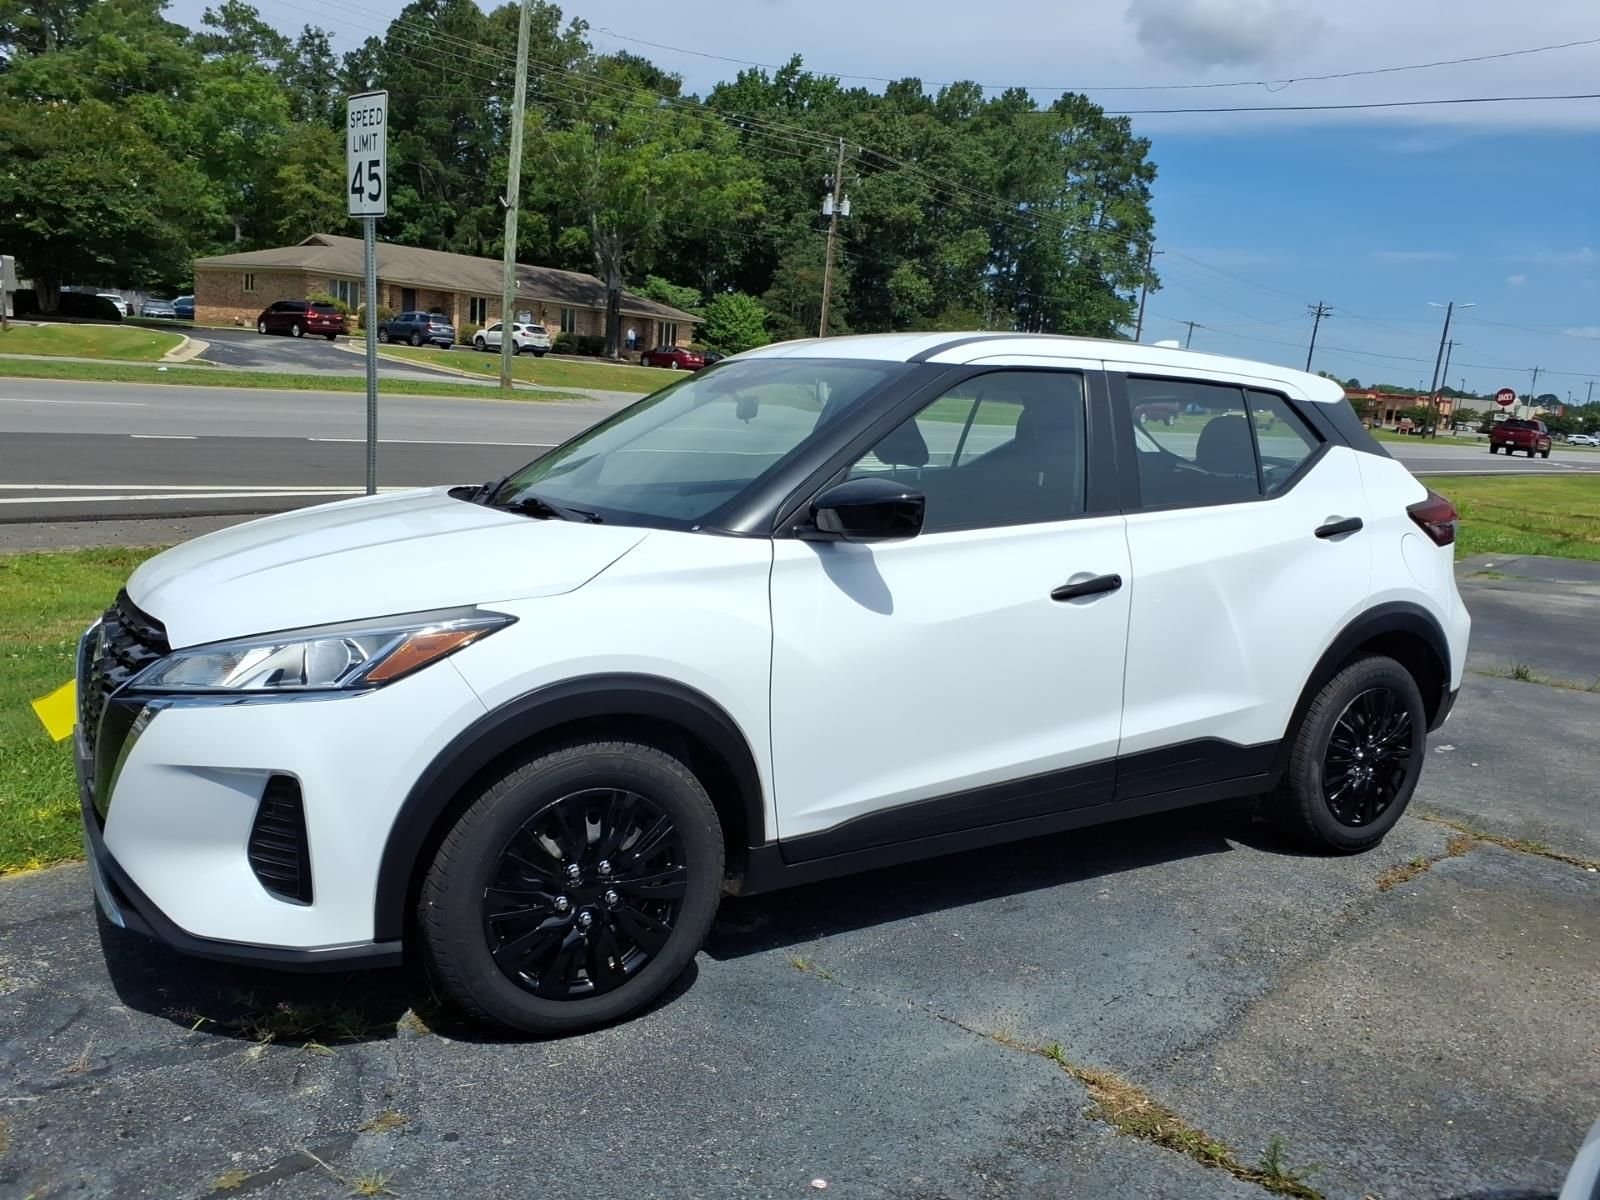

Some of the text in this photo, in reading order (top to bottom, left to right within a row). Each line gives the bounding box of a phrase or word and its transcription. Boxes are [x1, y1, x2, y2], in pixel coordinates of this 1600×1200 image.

[351, 107, 383, 128] SPEED
[353, 133, 378, 152] LIMIT
[351, 160, 382, 202] 45
